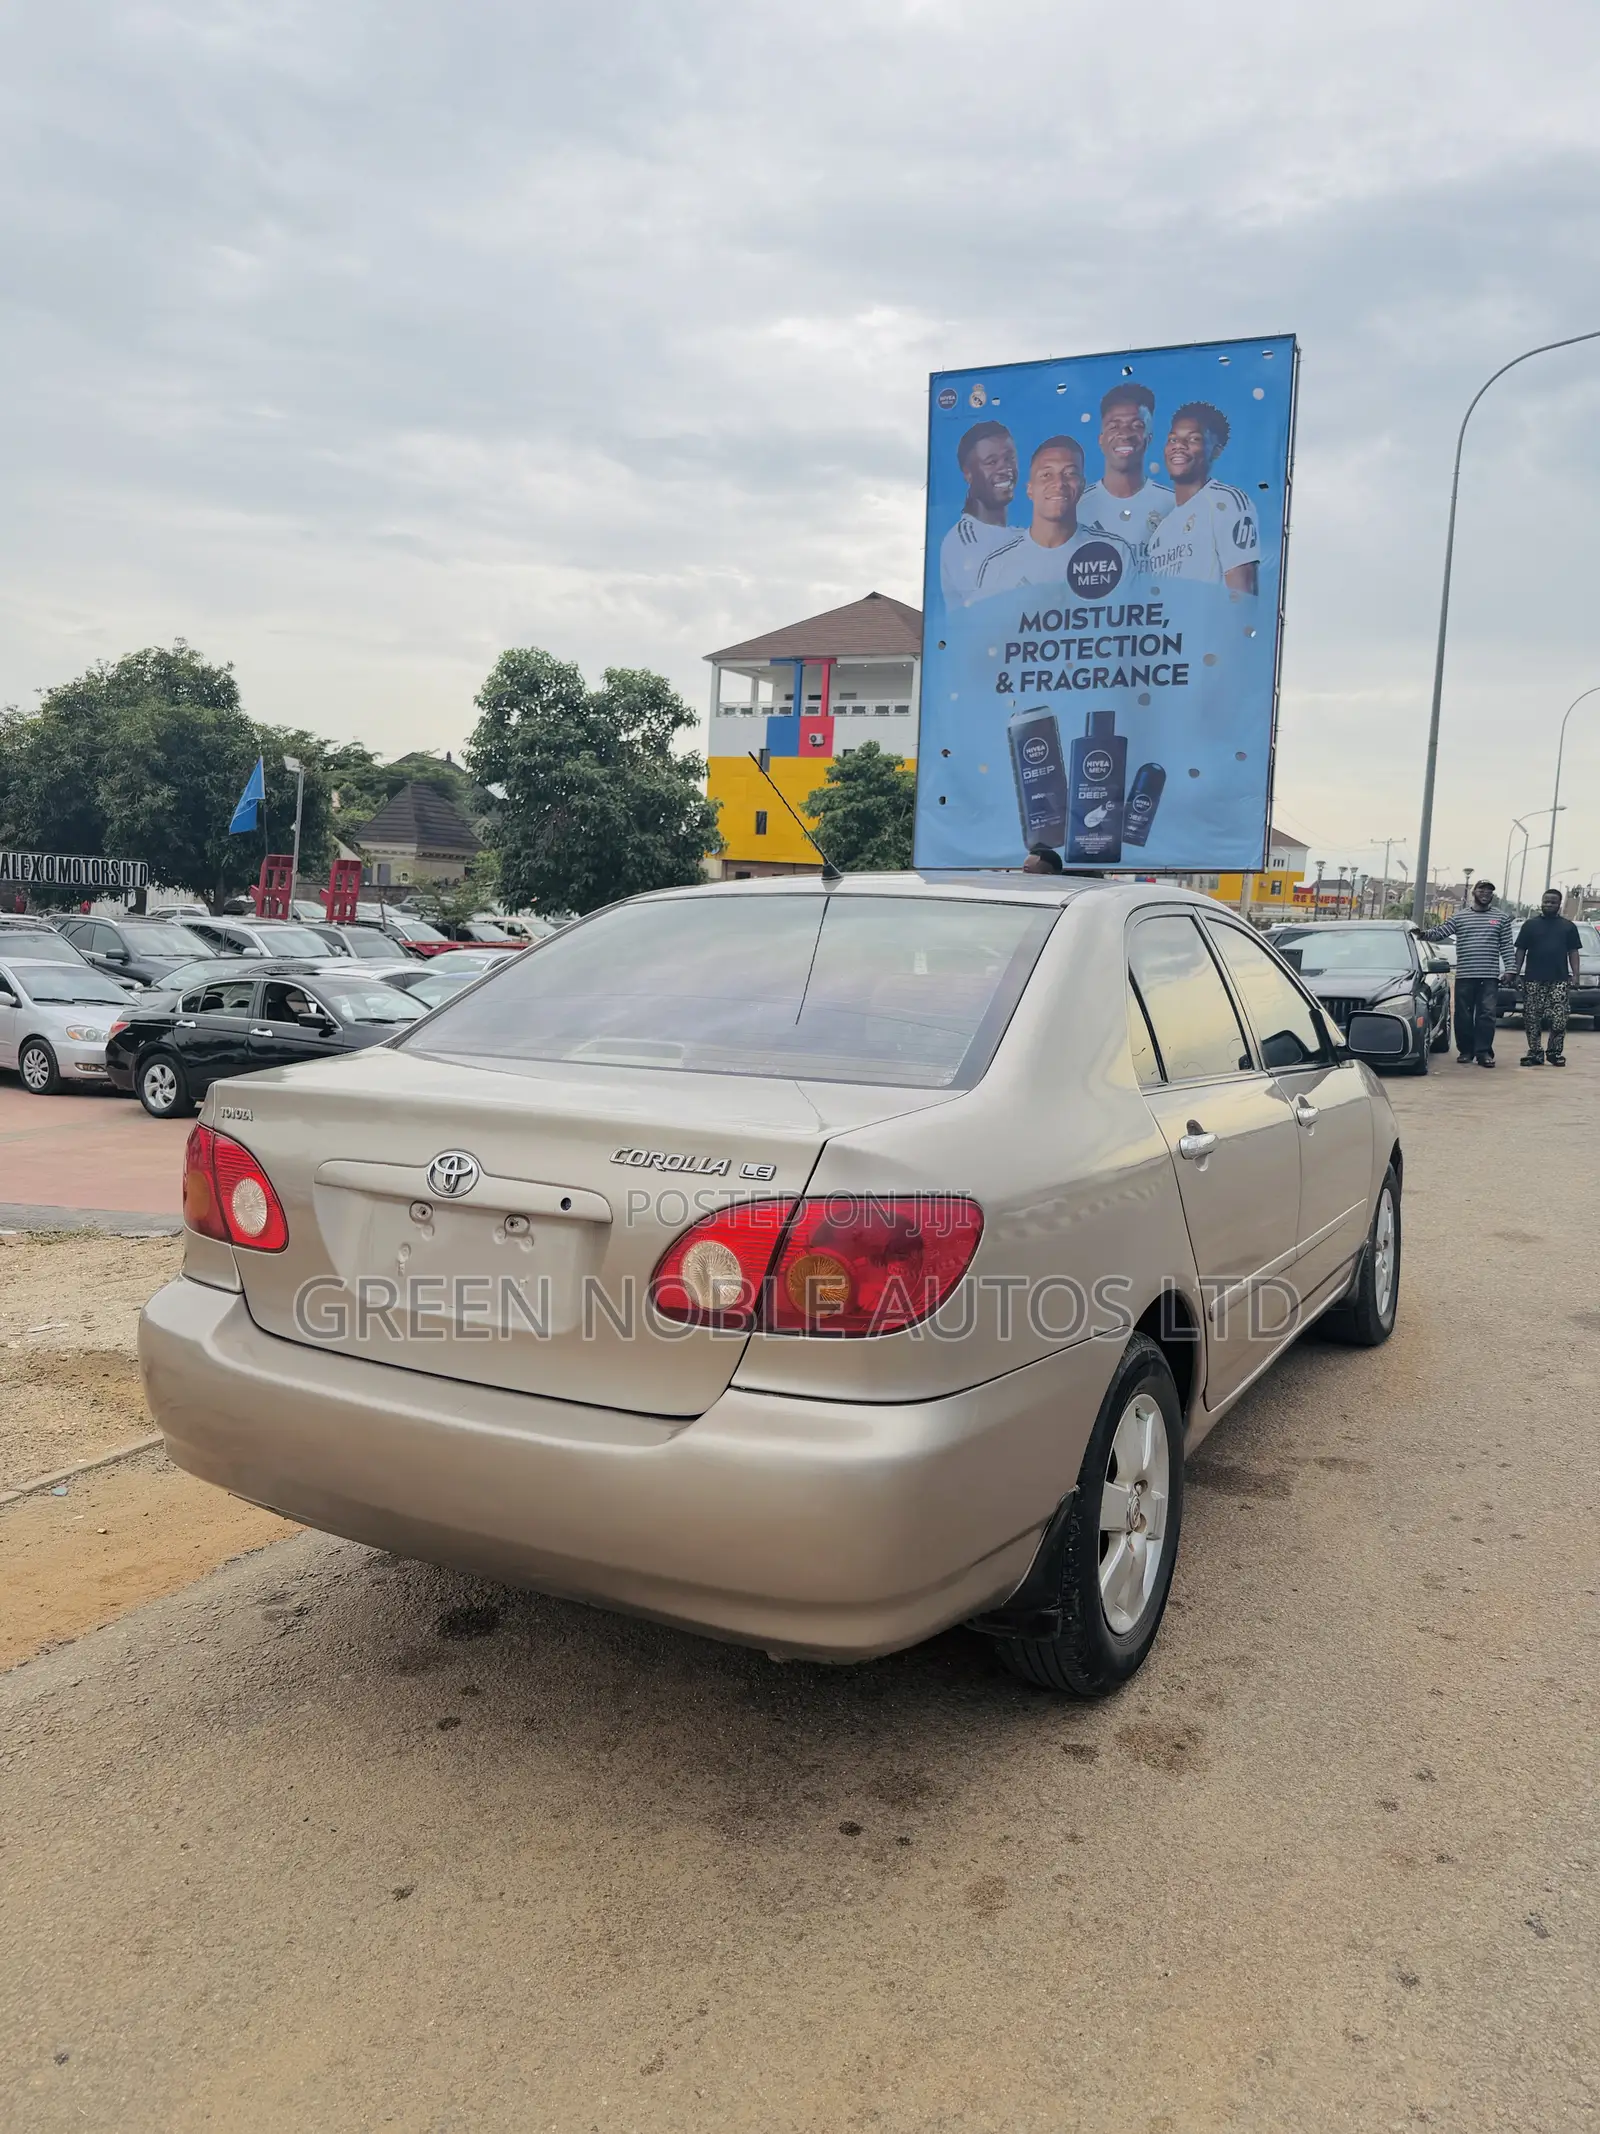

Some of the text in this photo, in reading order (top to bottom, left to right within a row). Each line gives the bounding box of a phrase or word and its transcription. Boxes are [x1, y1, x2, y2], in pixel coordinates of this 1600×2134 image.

[1072, 560, 1118, 574] NIVEA
[1077, 574, 1111, 586] MEN
[1018, 603, 1170, 634] MOISTURE,
[1004, 633, 1183, 664] PROTECTION
[995, 663, 1190, 694] & FRAGRANCE
[1026, 745, 1046, 754] NIVEA
[1029, 751, 1044, 759] MEN
[1086, 760, 1110, 768] NIVEA
[1088, 766, 1107, 774] MEN
[1023, 765, 1056, 780] DEEP
[1078, 791, 1109, 800] DEEP
[120, 860, 149, 888] LTD
[220, 1106, 254, 1122] TOYOTA
[610, 1147, 776, 1181] COROLLA LE
